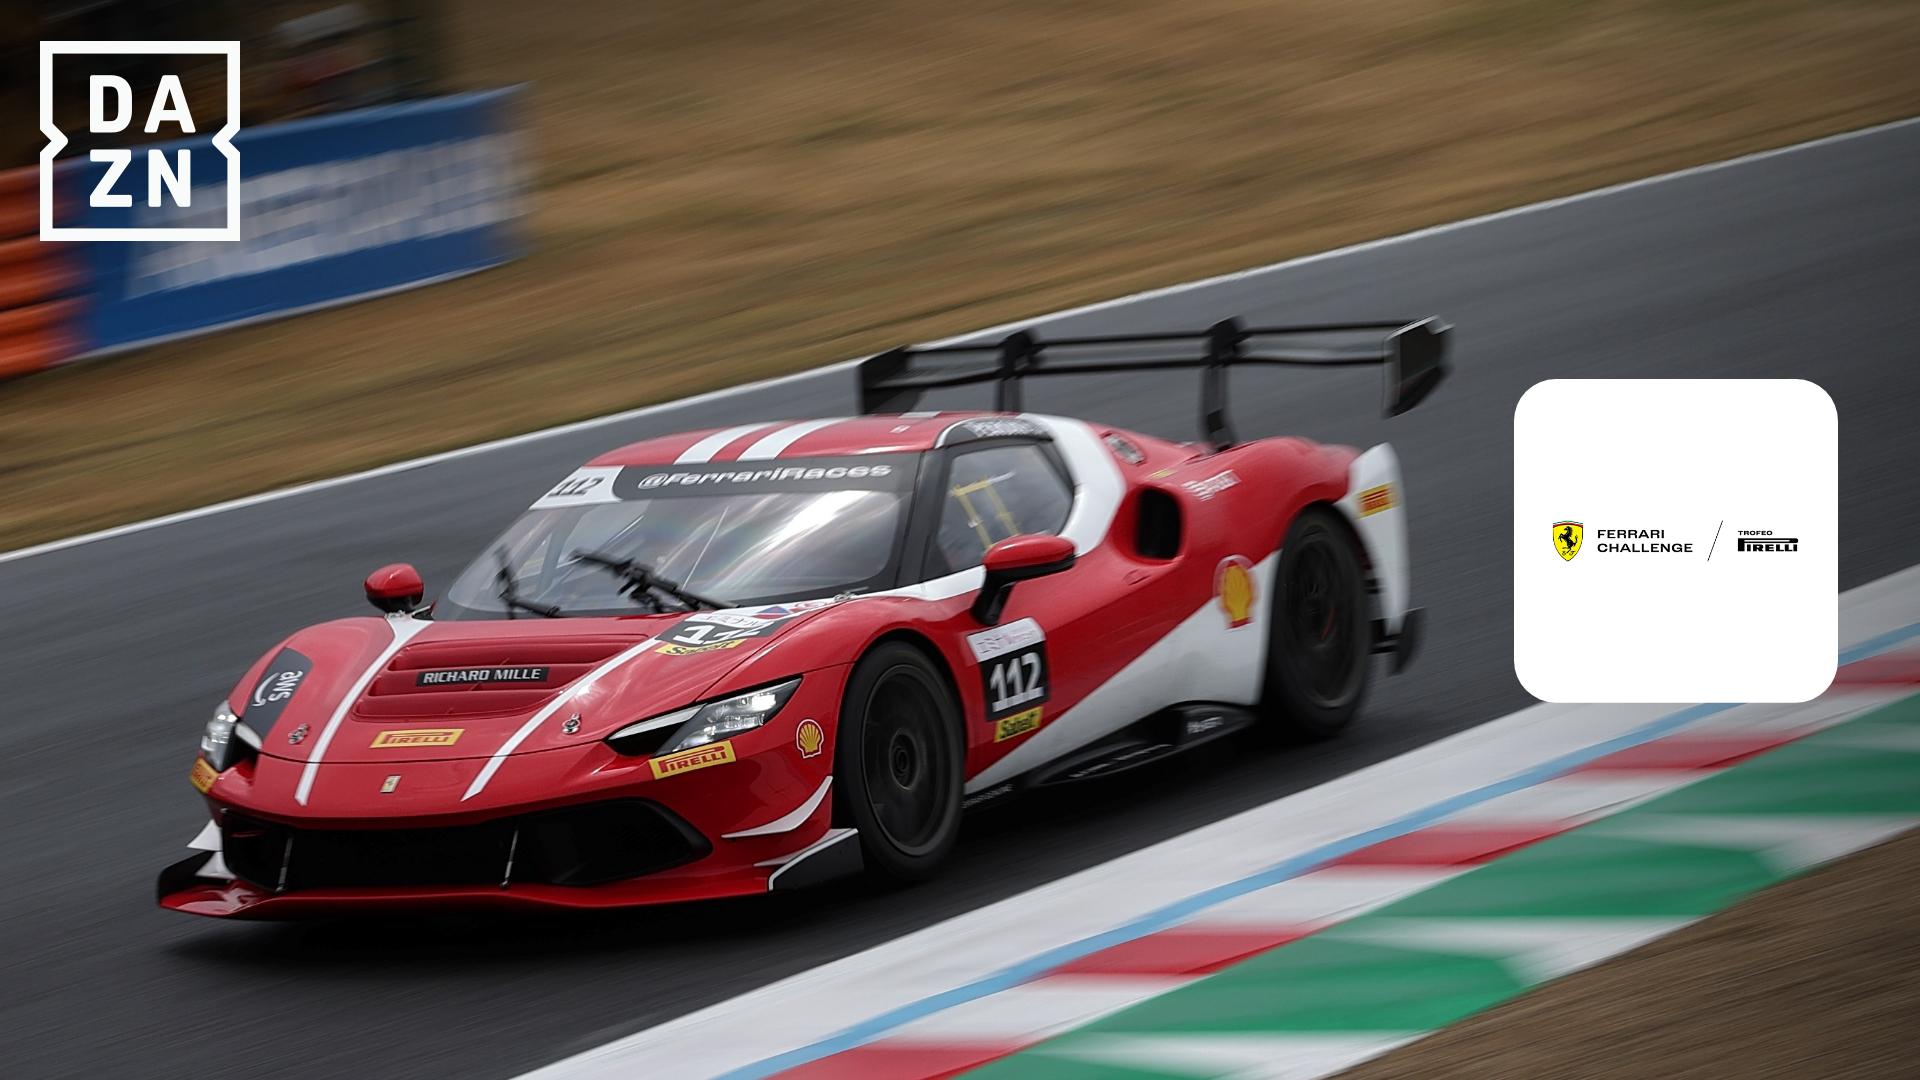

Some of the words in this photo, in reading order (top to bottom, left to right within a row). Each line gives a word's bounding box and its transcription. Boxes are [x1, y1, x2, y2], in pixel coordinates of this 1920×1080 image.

[637, 465, 892, 490] @FerrariRaces
[269, 670, 303, 702] aws
[423, 669, 489, 684] RICHARD
[493, 668, 542, 682] MILLE
[990, 652, 1044, 713] 112
[380, 731, 450, 746] PIRELLI
[658, 745, 728, 773] PIRELLI
